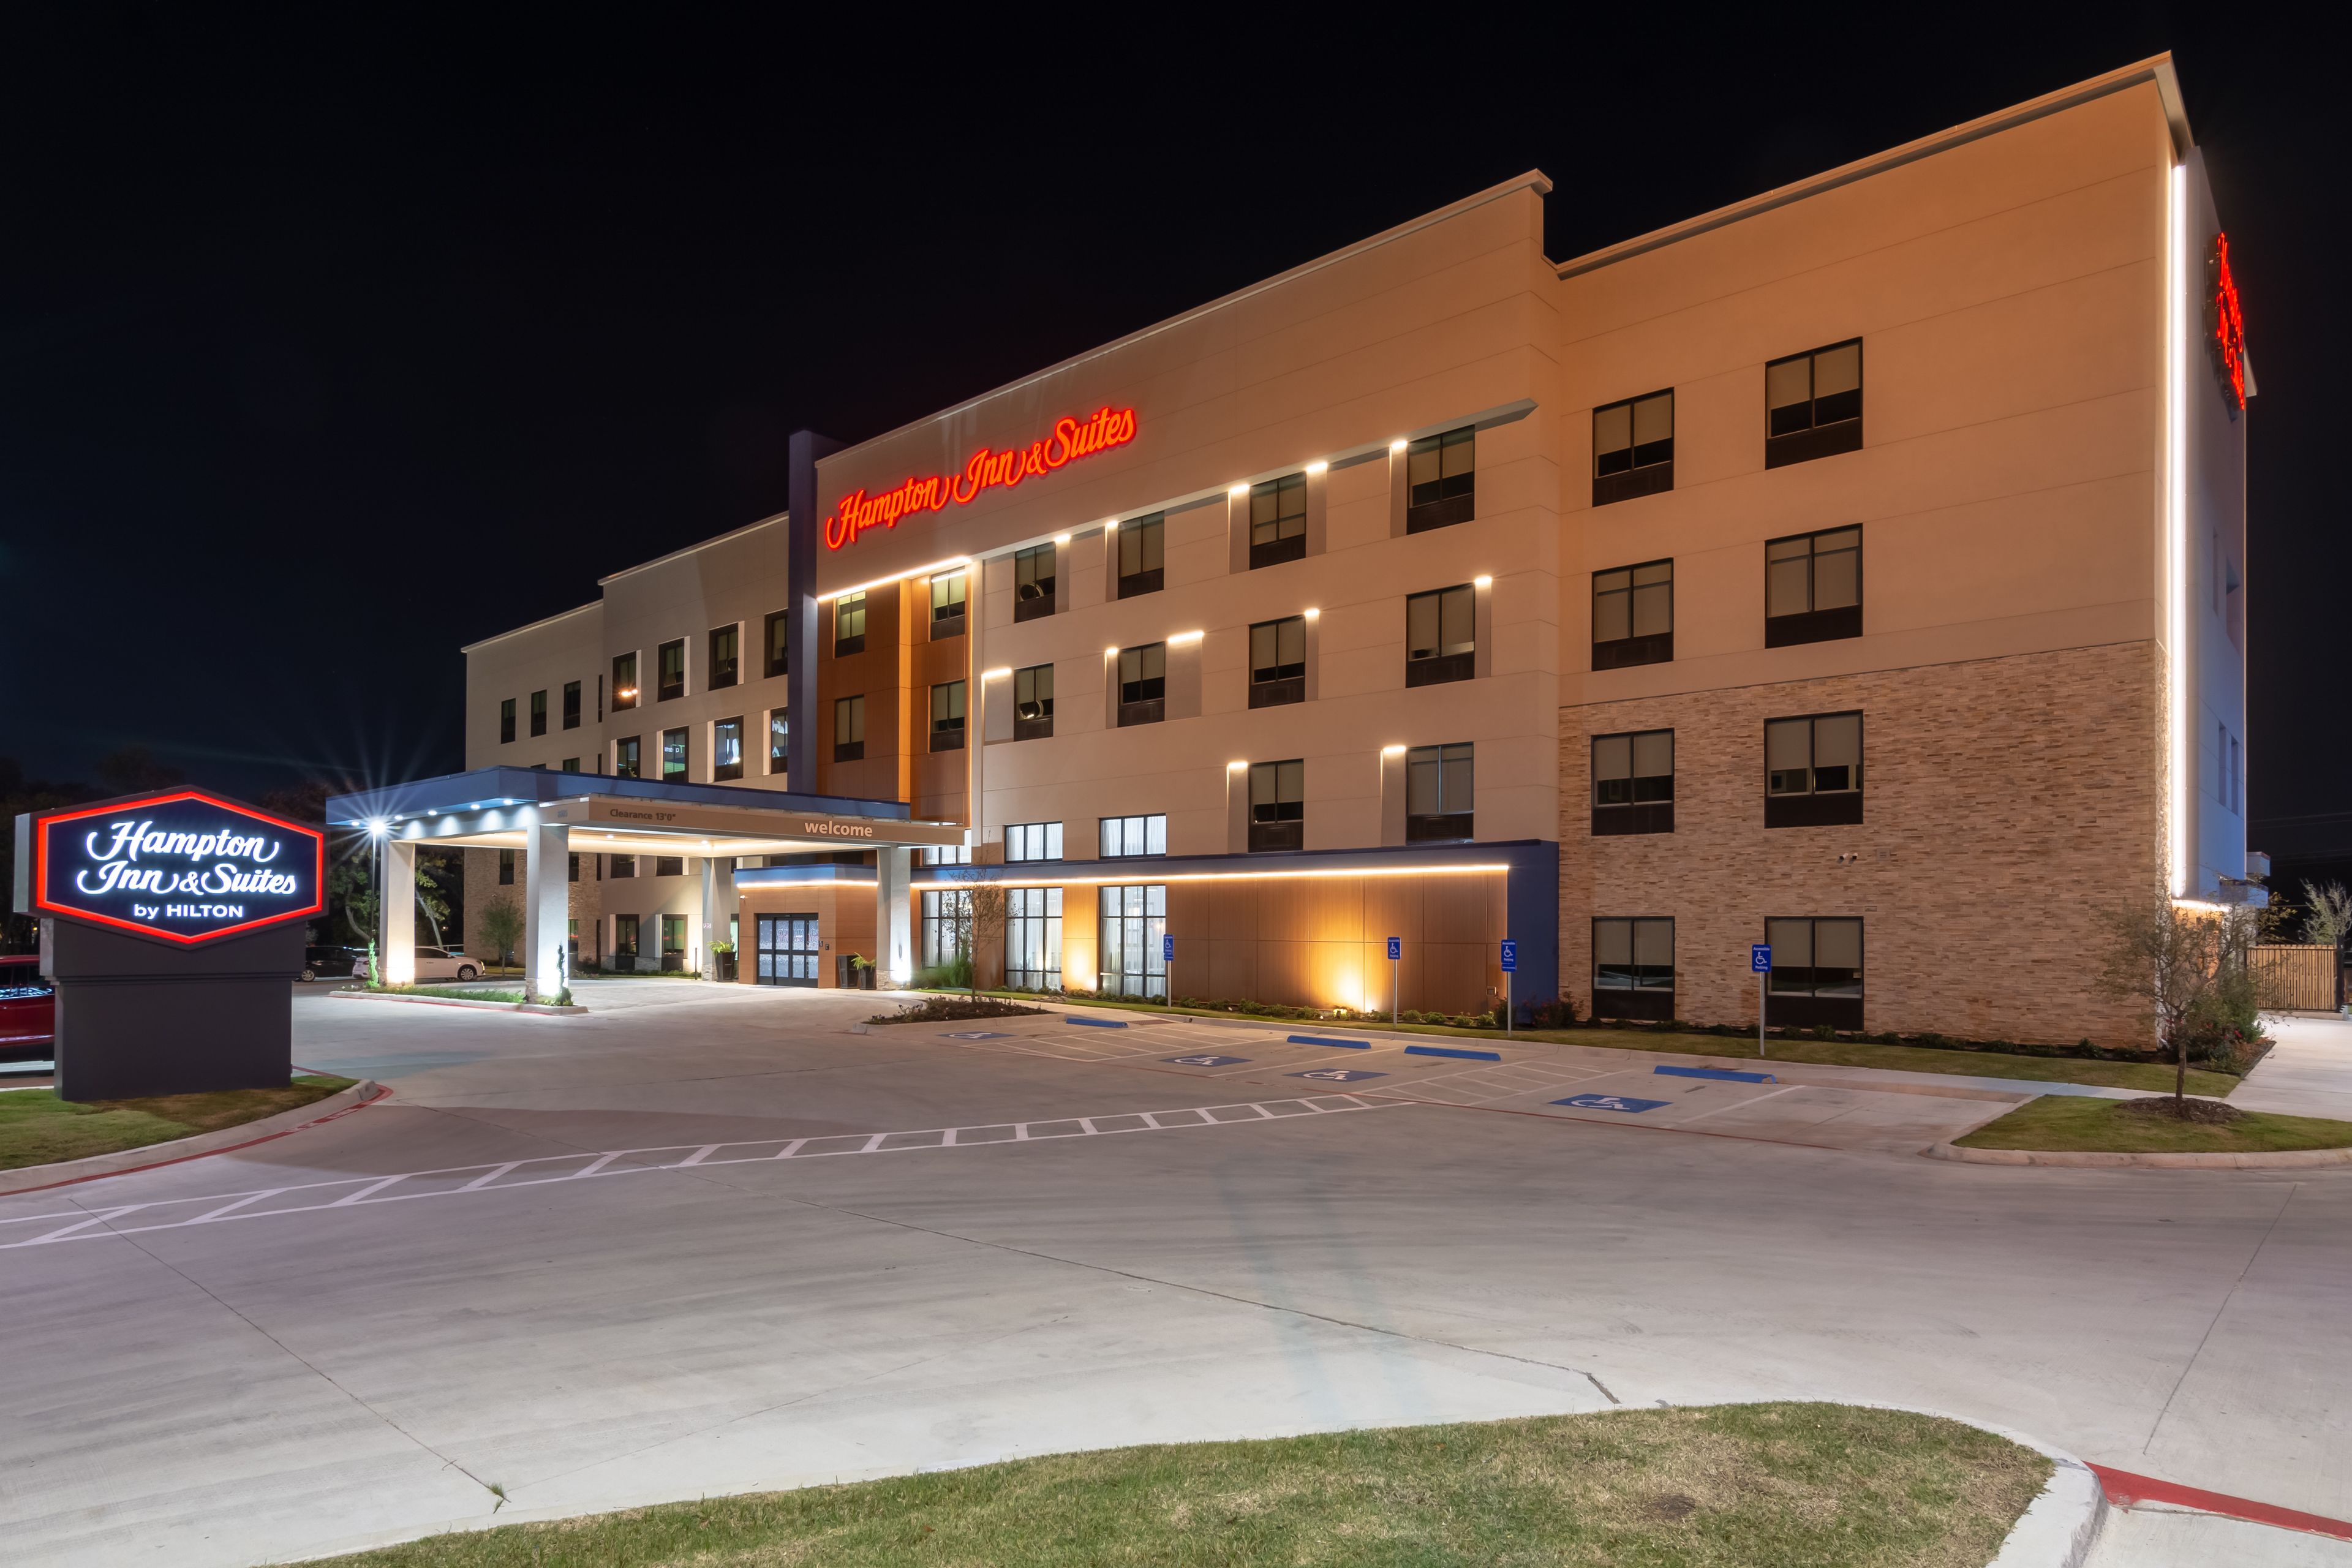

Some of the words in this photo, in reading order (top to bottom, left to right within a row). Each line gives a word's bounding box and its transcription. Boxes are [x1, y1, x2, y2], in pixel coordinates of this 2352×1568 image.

[826, 477, 951, 549] Hampton
[952, 449, 1027, 503] Inn
[1027, 443, 1047, 475] &
[1043, 407, 1136, 467] Suites
[609, 809, 653, 820] Clearance
[804, 820, 873, 837] welcome
[86, 821, 279, 862] Hampton
[77, 861, 179, 894] Inn
[179, 872, 204, 895] &
[201, 863, 296, 894] Suites
[134, 904, 159, 919] by
[167, 905, 243, 918] HILTON
